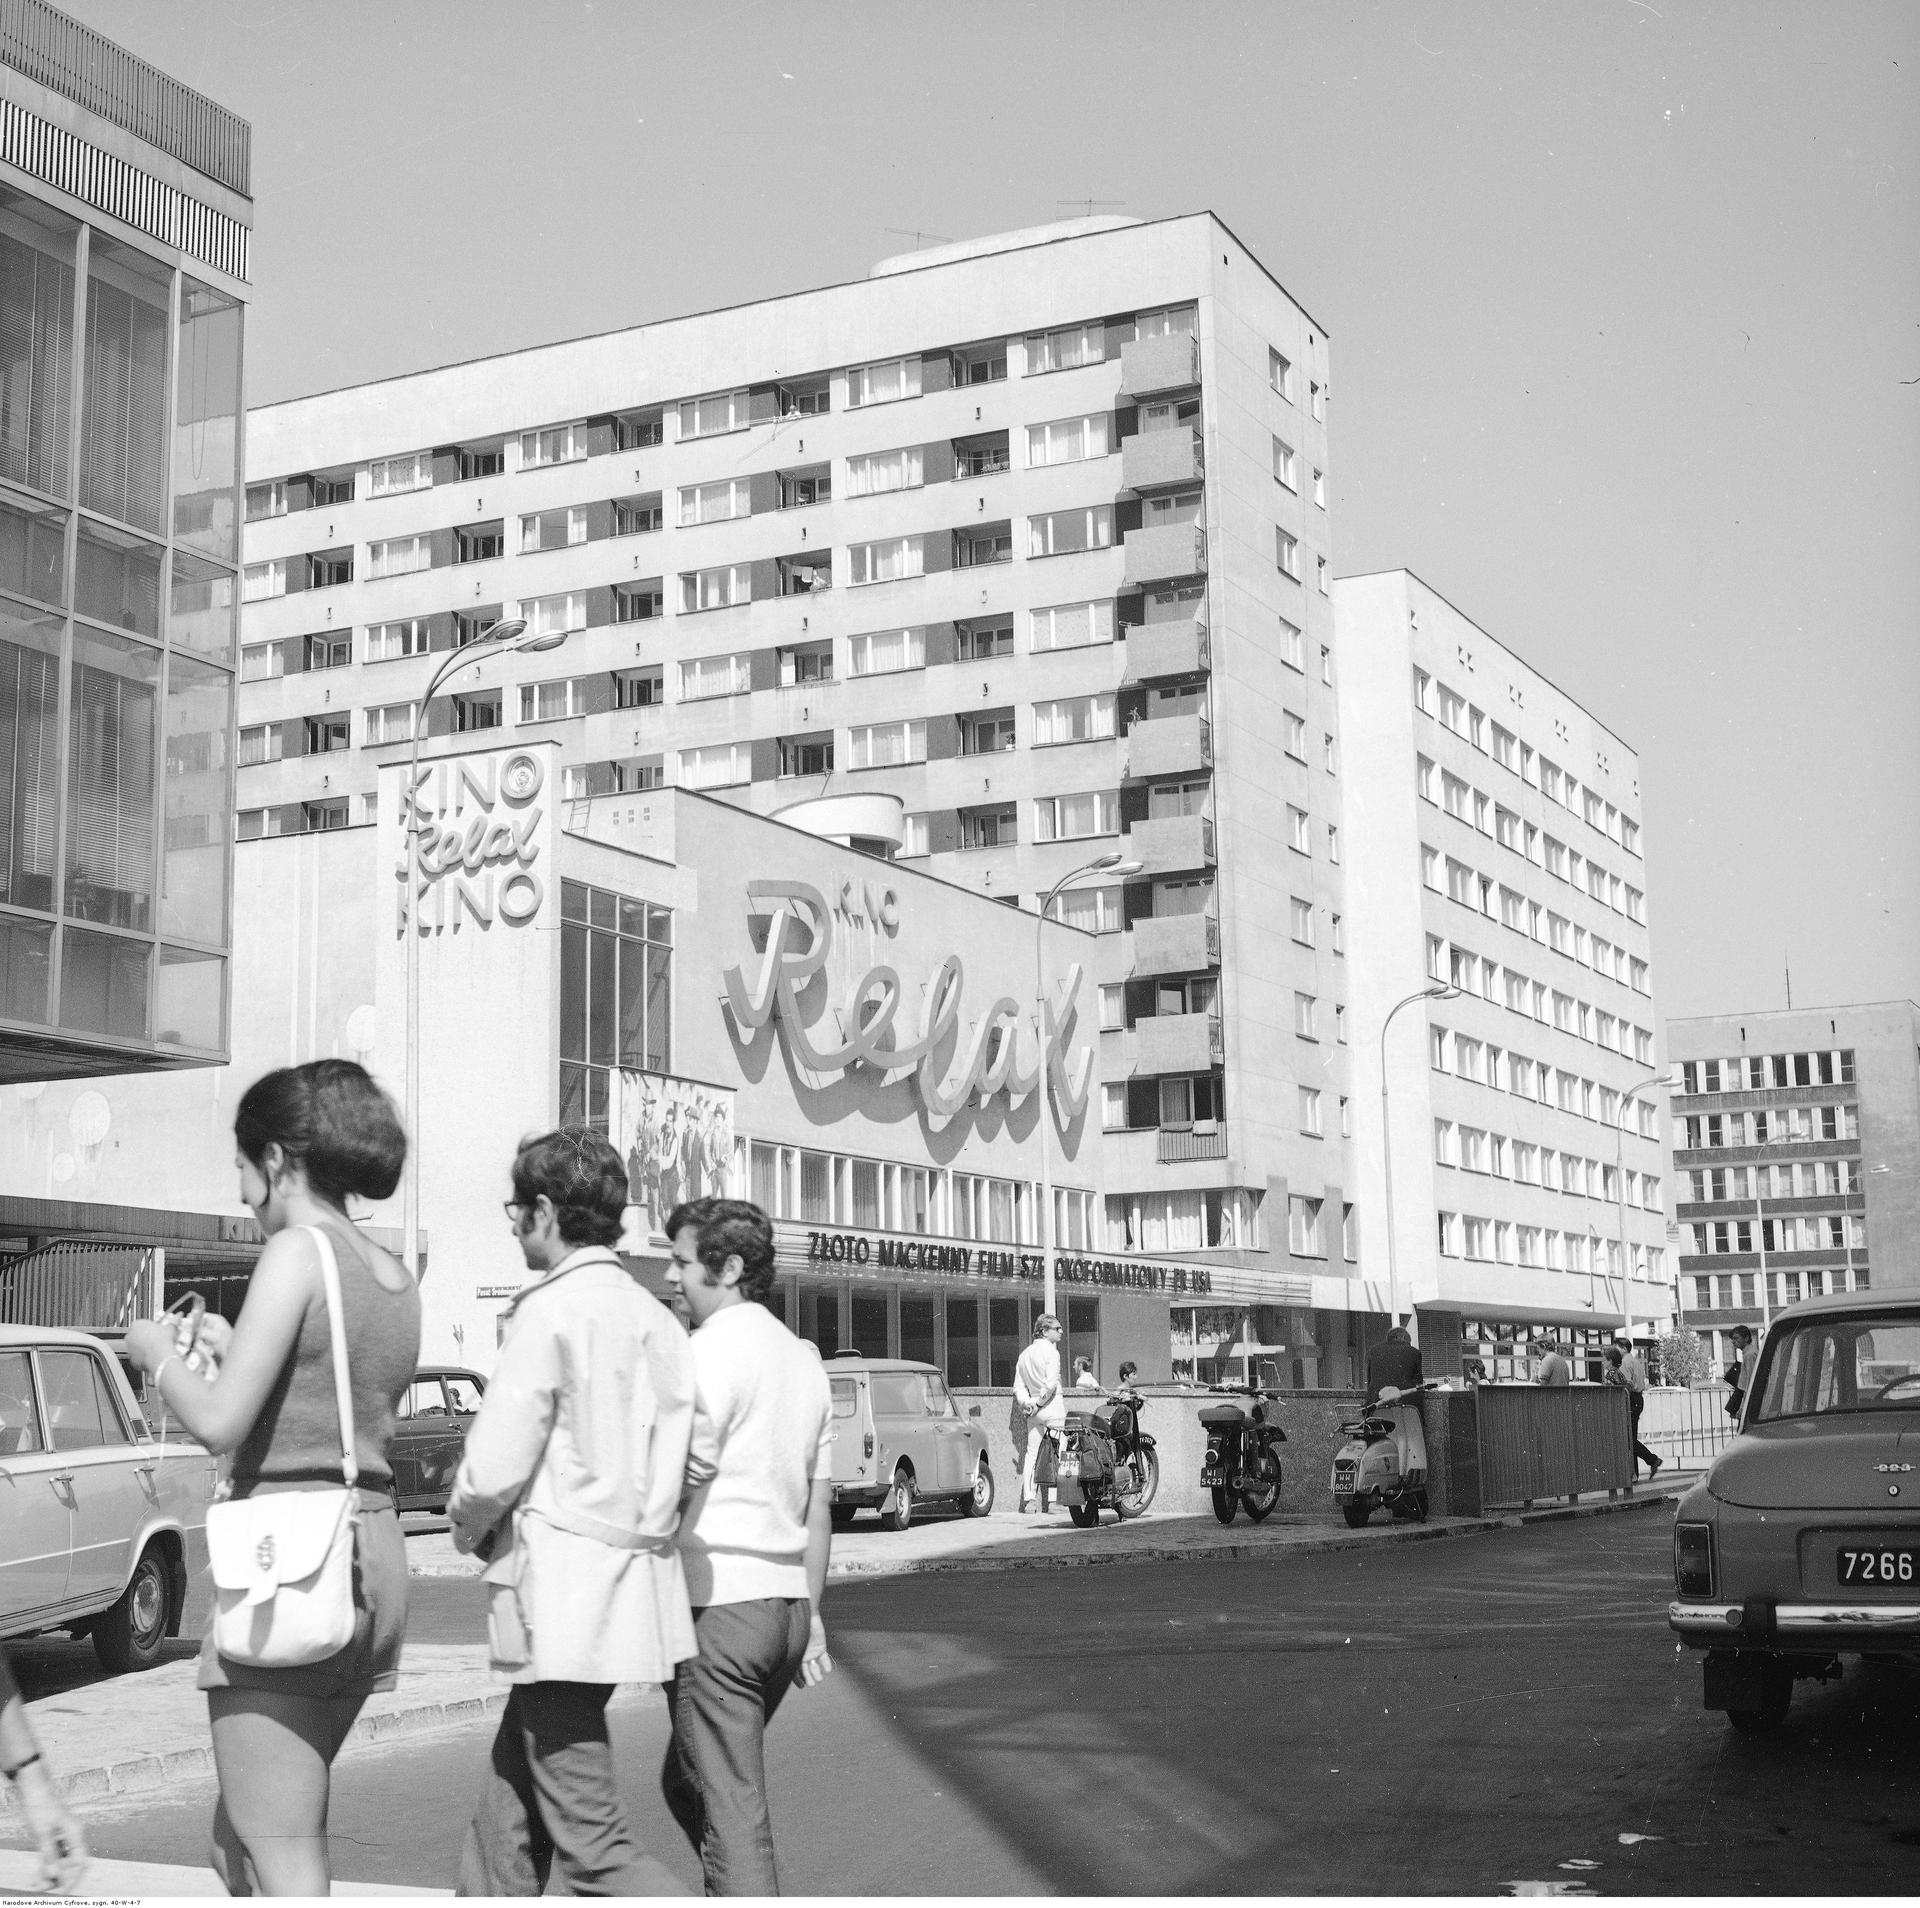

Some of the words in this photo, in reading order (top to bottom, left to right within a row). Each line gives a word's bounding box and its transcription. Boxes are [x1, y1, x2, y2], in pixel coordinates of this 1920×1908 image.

[399, 751, 544, 817] KINO
[395, 807, 544, 875] Relax
[397, 869, 544, 931] KINO
[722, 879, 1096, 1118] Relax
[808, 1231, 870, 1265] ZŁOTO
[878, 1239, 972, 1275] MACKENNY
[978, 1250, 1014, 1278] FILM
[1191, 1270, 1212, 1293] USA
[1201, 1477, 1223, 1486] 5423
[1335, 1483, 1353, 1491] 8047
[1339, 1473, 1351, 1481] WW
[1844, 1553, 1913, 1581] 7266
